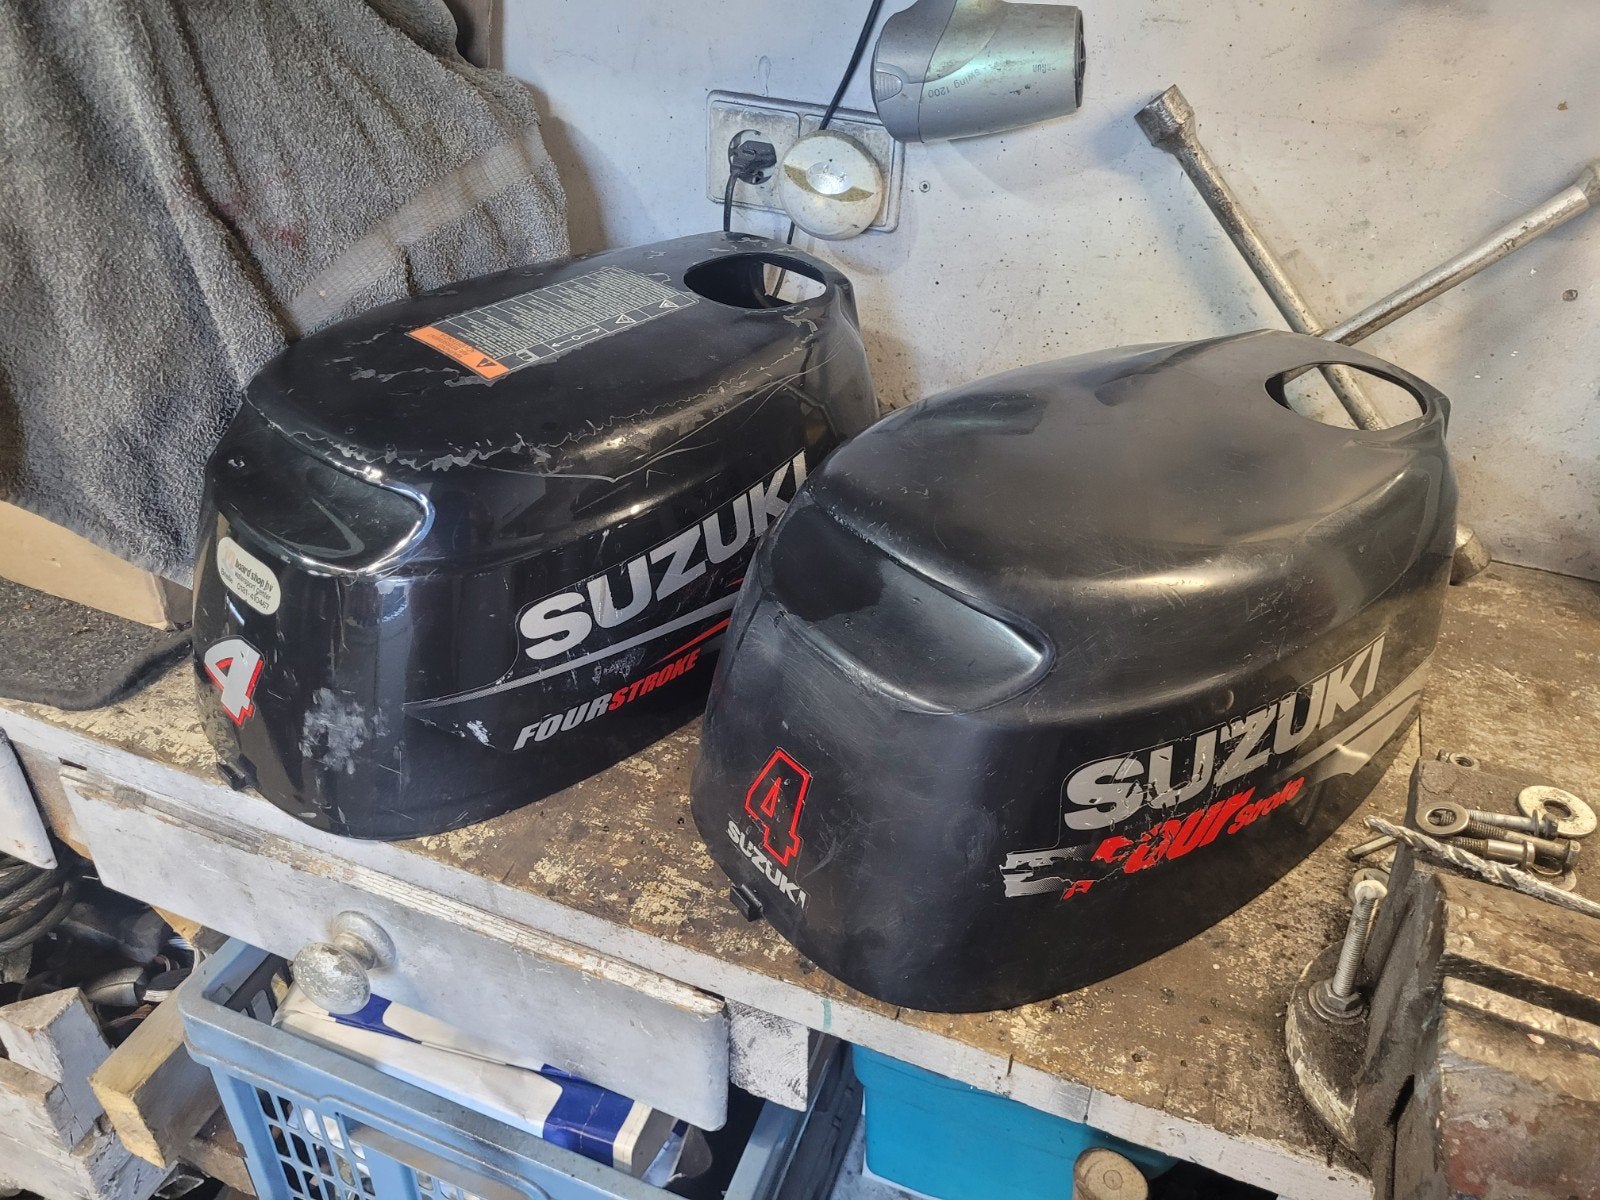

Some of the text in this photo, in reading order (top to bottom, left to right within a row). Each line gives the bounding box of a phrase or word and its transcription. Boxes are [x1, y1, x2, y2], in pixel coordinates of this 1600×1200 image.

[927, 69, 981, 99] swing 1200
[519, 451, 807, 660] SUZUKI
[204, 638, 264, 727] 4
[1064, 636, 1385, 831] SUZUKI
[744, 747, 811, 867] 4
[727, 820, 807, 910] SUZUKI
